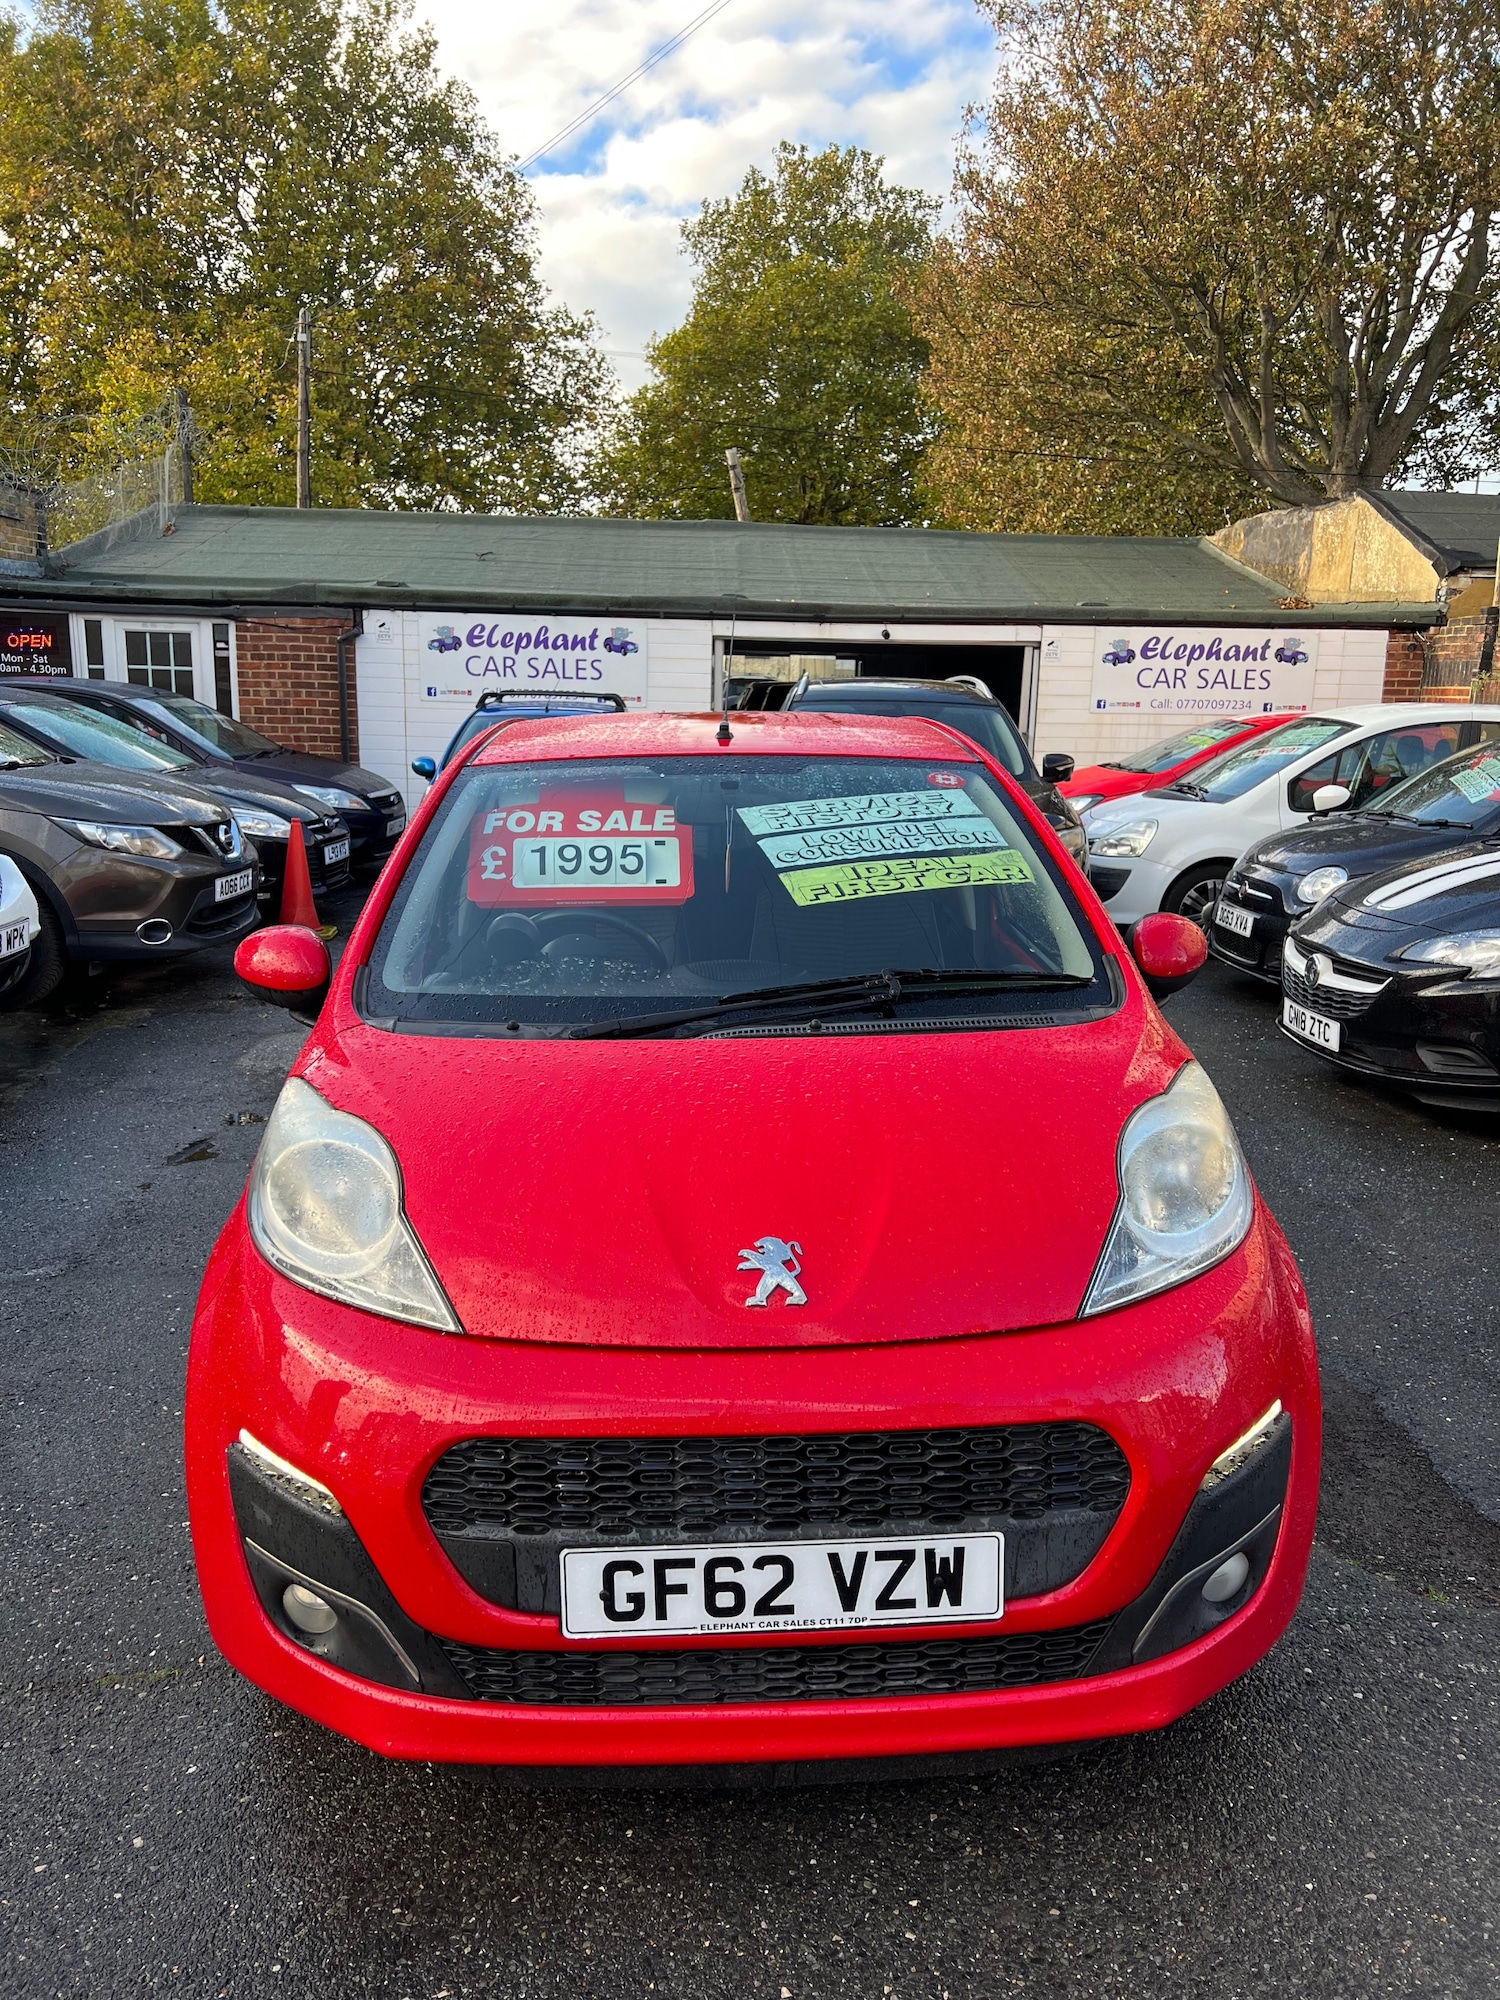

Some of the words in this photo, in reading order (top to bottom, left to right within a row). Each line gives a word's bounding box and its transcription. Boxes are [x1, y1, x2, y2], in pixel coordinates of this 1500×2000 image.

[7, 634, 52, 648] OPEN
[466, 623, 599, 655] Elephant
[1140, 636, 1271, 667] Elephant
[1, 653, 24, 663] Mon
[32, 654, 49, 664] Sat
[30, 664, 67, 676] 4.30pm
[465, 655, 517, 678] CAR
[527, 657, 603, 681] SALES
[1136, 667, 1187, 690] CAR
[1196, 668, 1271, 690] SALES
[1150, 699, 1173, 710] Call:
[1176, 699, 1252, 710] 07707097234
[758, 791, 946, 818] SERVICE
[766, 801, 954, 831] HISTORY
[483, 809, 564, 835] FOR
[576, 809, 676, 832] SALE
[802, 827, 870, 848] LOW
[878, 821, 957, 840] FUEL
[776, 831, 999, 863] CONSUMPTION
[480, 845, 507, 880] £
[531, 844, 644, 876] 1995
[840, 855, 971, 880] IDEAL
[798, 871, 925, 902] FIRST
[935, 865, 1029, 884] CAR
[6, 924, 25, 951] WPK
[1309, 1015, 1331, 1043] ZTC
[602, 1554, 796, 1622] GF62
[826, 1546, 966, 1613] VZW
[700, 1621, 756, 1631] ELEPHANT
[758, 1620, 780, 1629] CAR
[783, 1619, 816, 1628] SALES
[819, 1617, 844, 1625] CT11
[848, 1616, 868, 1624] 7DP
